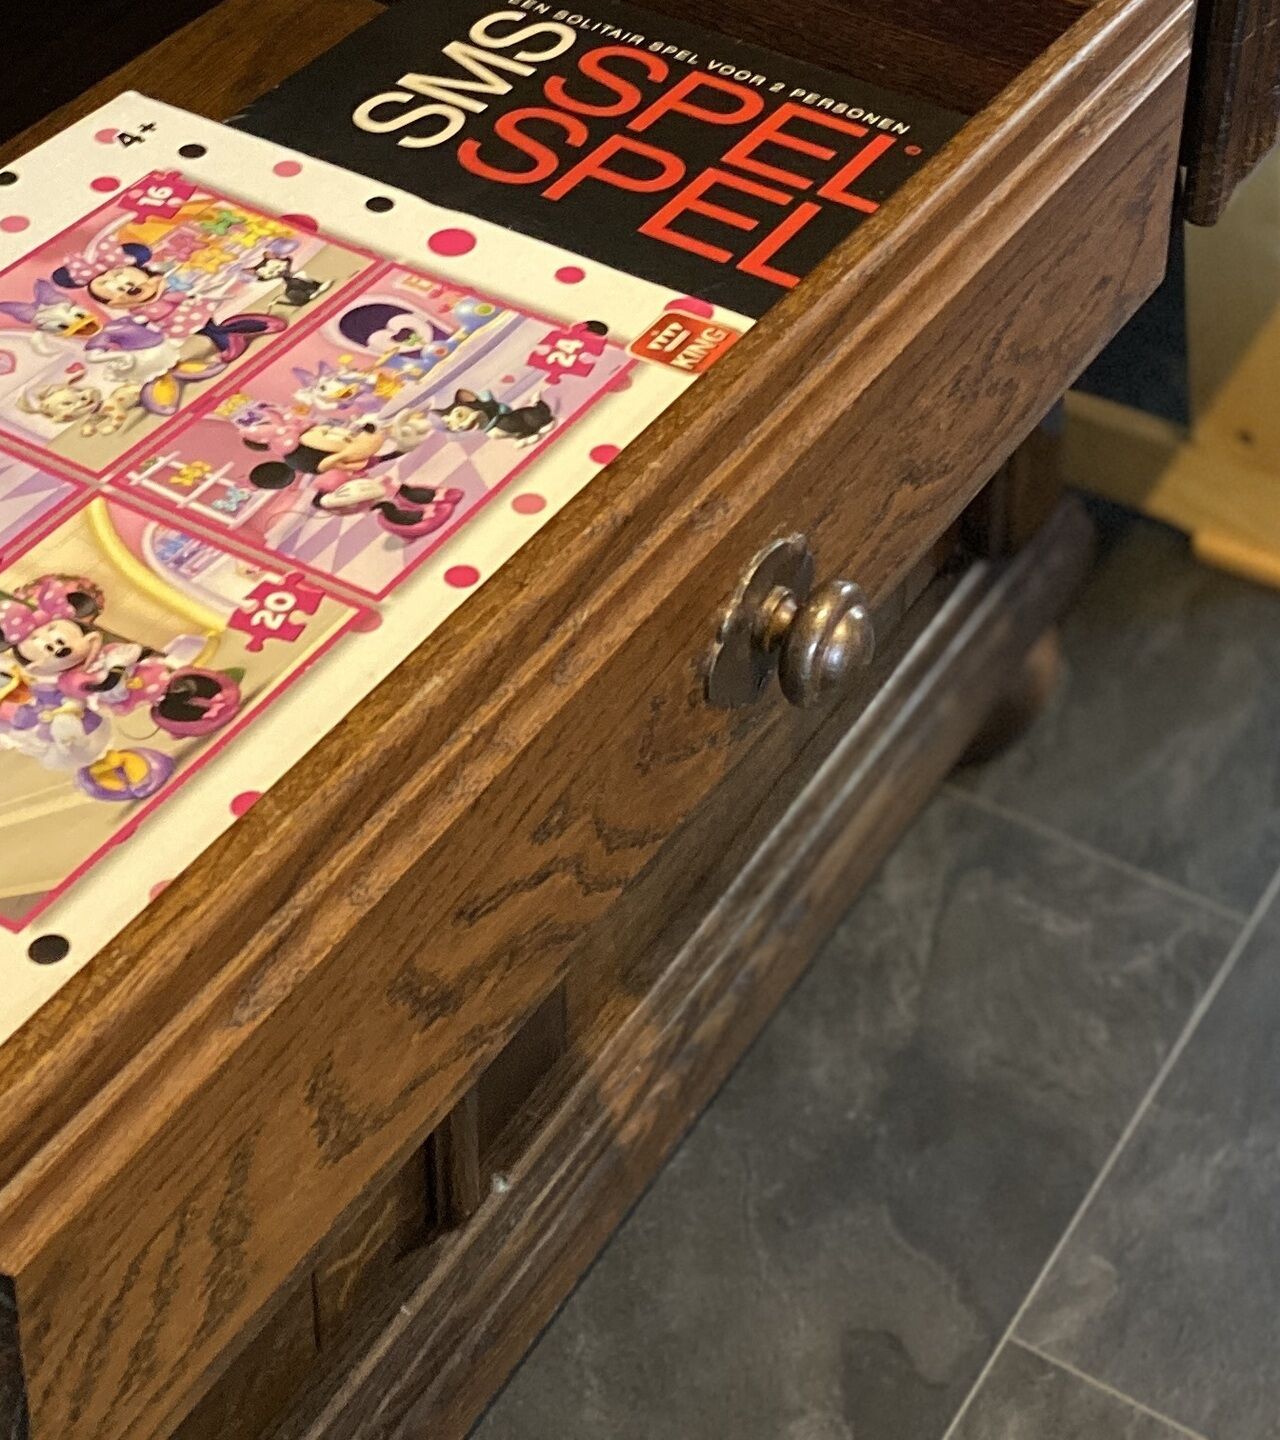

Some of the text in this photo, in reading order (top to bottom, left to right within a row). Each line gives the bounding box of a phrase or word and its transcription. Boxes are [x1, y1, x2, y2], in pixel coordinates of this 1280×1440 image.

[552, 9, 646, 46] SOLITAIR
[648, 41, 699, 65] SPEL
[706, 59, 767, 87] VOOR
[768, 81, 787, 94] 2
[788, 87, 911, 135] PERSONEN
[351, 9, 898, 215] SMS SPEL
[116, 122, 157, 149] 4+
[136, 185, 174, 208] 16
[456, 106, 823, 288] SPEL
[546, 338, 585, 368] 24
[671, 326, 730, 370] KING
[249, 590, 298, 631] 20
